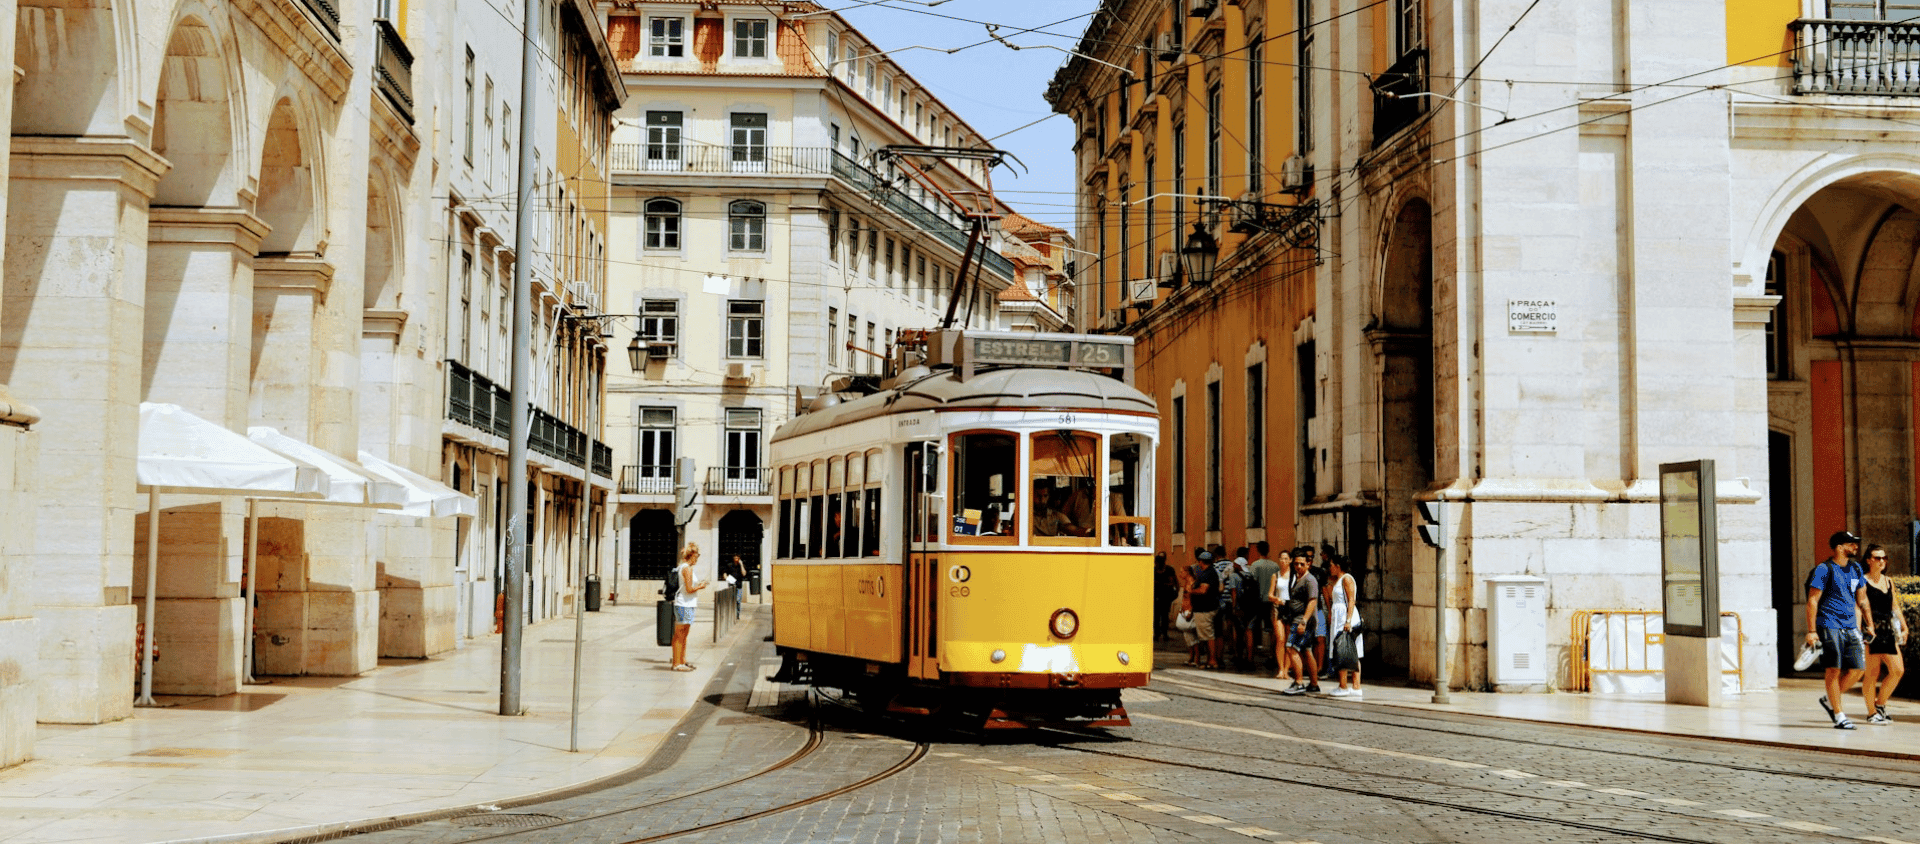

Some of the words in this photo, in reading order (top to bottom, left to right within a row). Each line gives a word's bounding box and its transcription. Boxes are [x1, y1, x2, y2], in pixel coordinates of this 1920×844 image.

[1517, 300, 1549, 308] PRAÇA
[1511, 312, 1556, 321] COMERCIO
[979, 340, 1063, 357] ESTRELA
[1081, 343, 1110, 363] 25
[1058, 414, 1076, 425] 581
